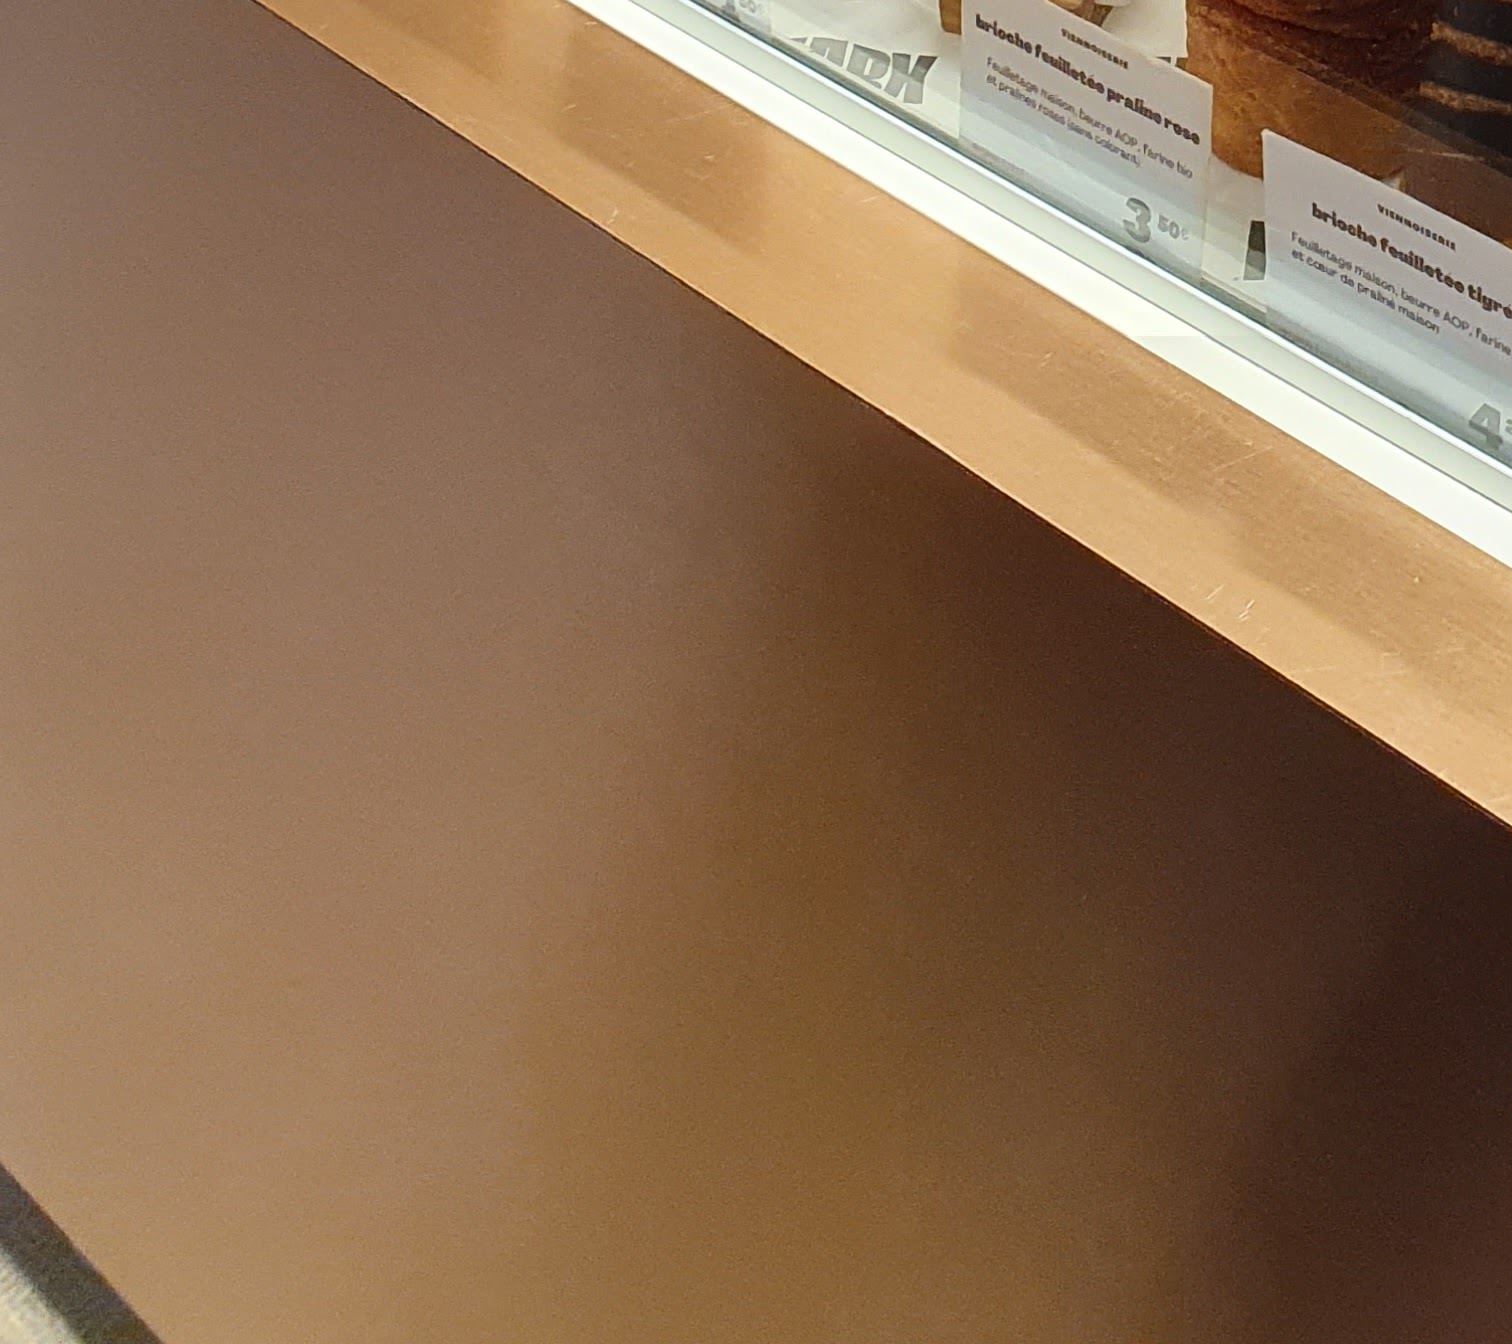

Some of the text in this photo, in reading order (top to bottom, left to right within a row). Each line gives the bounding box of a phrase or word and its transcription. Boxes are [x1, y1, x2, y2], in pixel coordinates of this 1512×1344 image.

[975, 13, 1033, 54] brioche
[1106, 87, 1162, 126] praline
[1164, 114, 1201, 146] rose
[1176, 160, 1193, 180] bio
[1311, 201, 1378, 249] brioche
[1340, 271, 1356, 290] de
[1397, 304, 1441, 336] maison
[1475, 325, 1512, 358] farine
